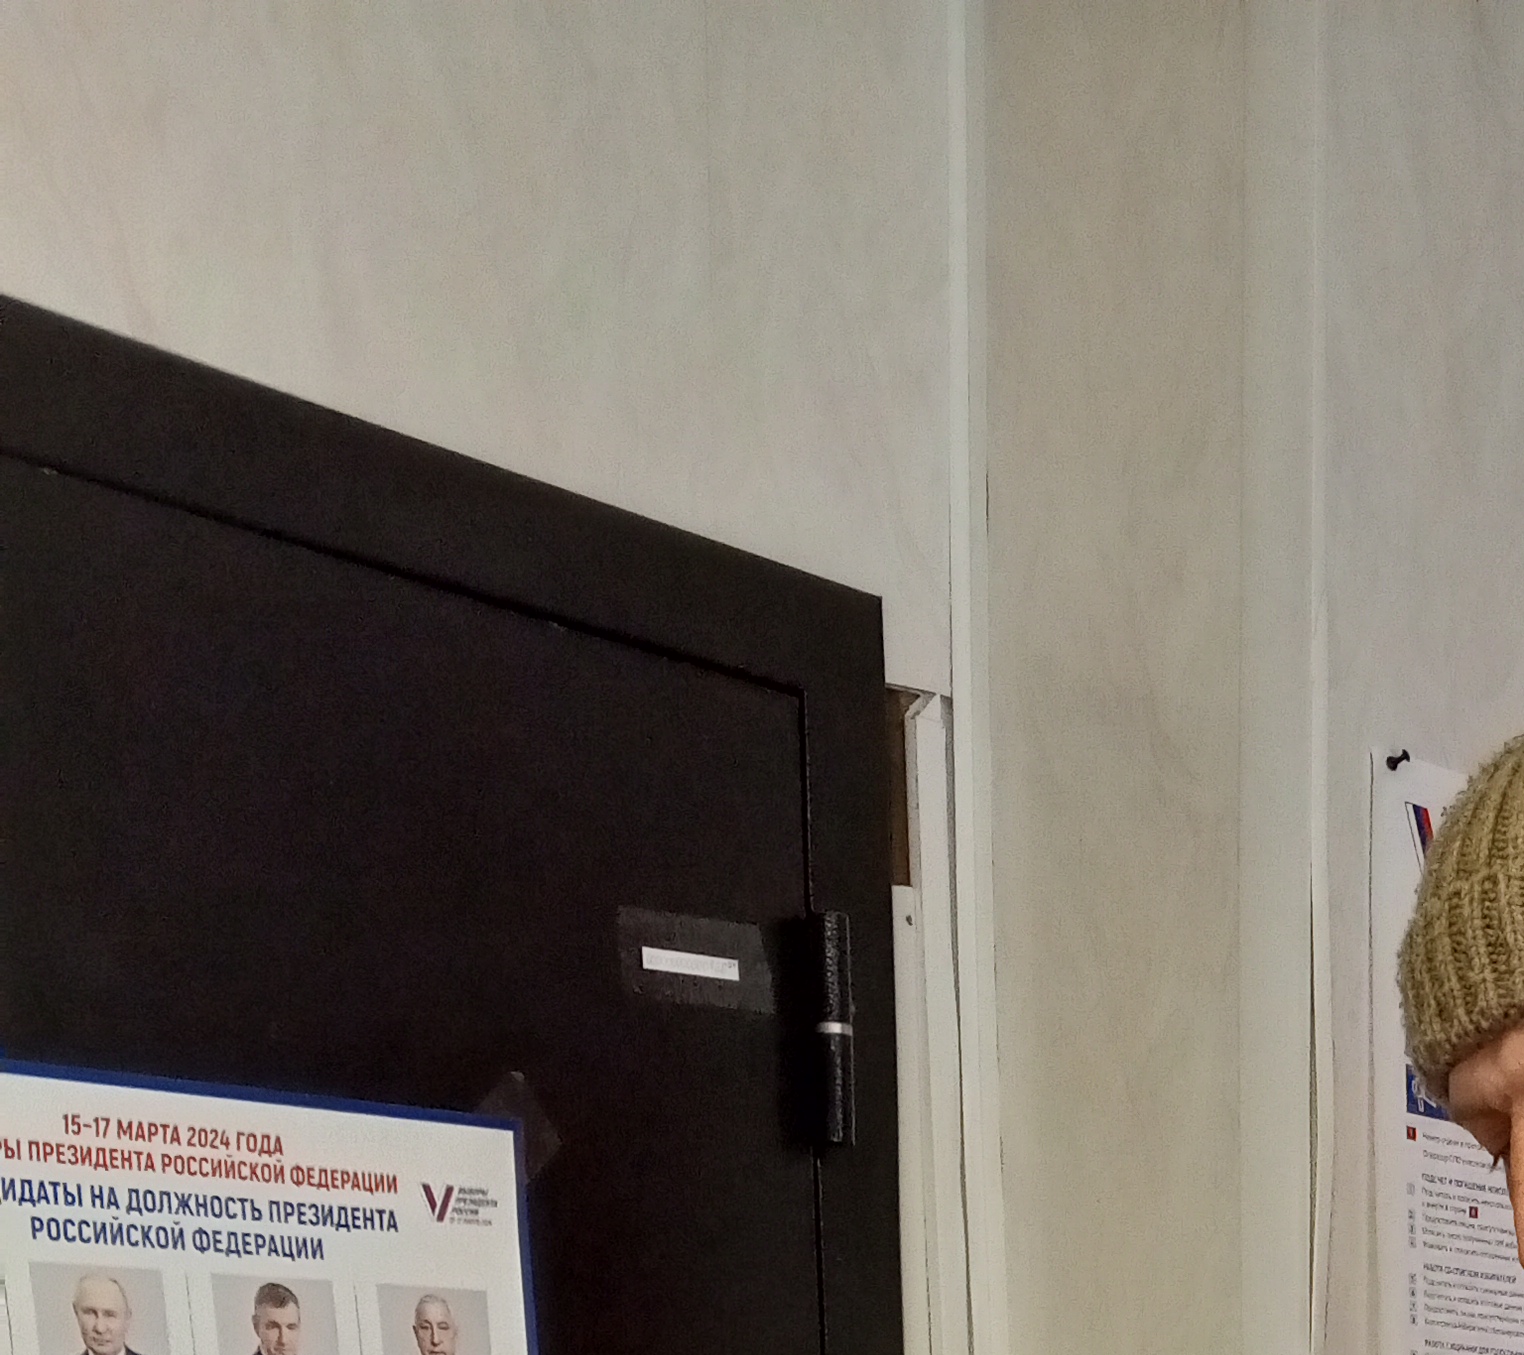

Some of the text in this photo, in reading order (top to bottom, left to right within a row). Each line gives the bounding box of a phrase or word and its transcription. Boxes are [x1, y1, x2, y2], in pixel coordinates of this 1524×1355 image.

[63, 1113, 284, 1157] 15-17 МАРТА 2024 ГОДА
[28, 1140, 157, 1173] ПРЕЗИДЕНТА
[161, 1153, 286, 1185] РОССИЙСКОЙ
[290, 1165, 399, 1195] ФЕДЕРАЦИИ
[0, 1176, 399, 1233] ИДАТЫ НА ДОЛЖНОСТЬ ПРЕЗИДЕНТА
[30, 1215, 325, 1262] РОССИЙСКОЙ ФЕДЕРАЦИИ
